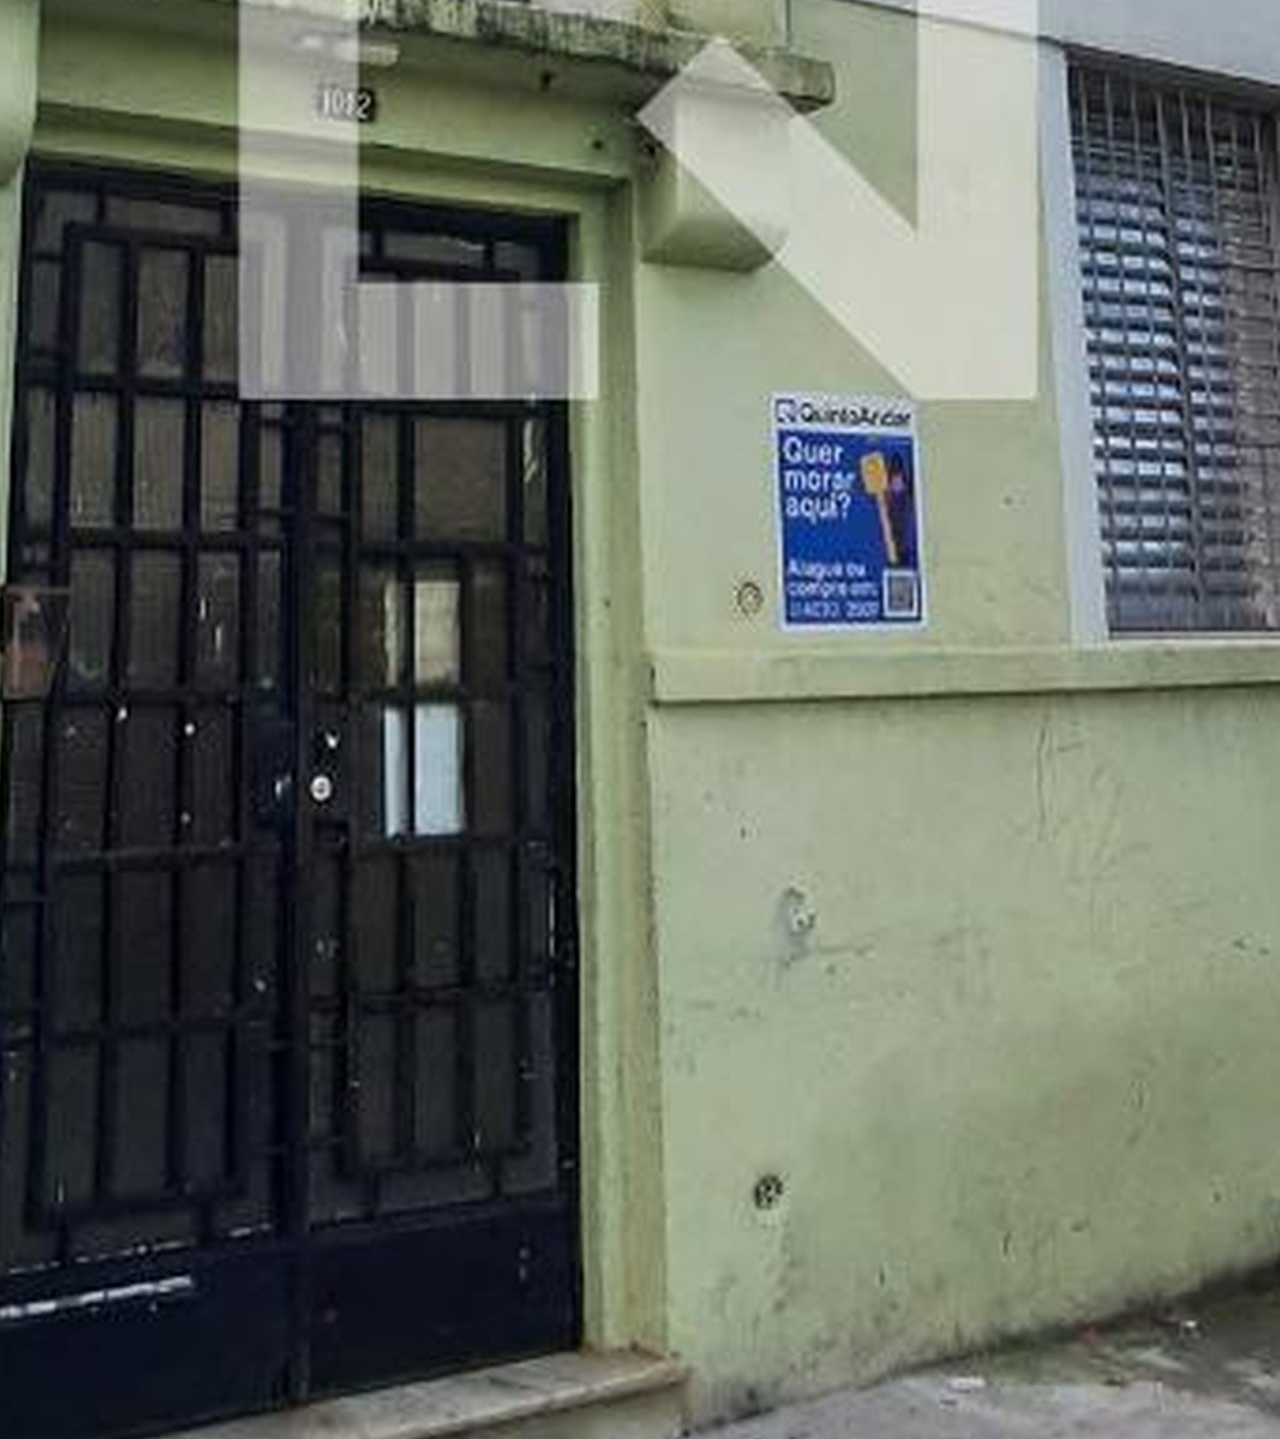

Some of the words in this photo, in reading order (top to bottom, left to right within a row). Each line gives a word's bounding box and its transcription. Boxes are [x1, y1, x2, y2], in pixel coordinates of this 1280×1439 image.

[784, 436, 843, 464] Quer
[784, 471, 855, 490] morar
[785, 492, 852, 524] aqui?
